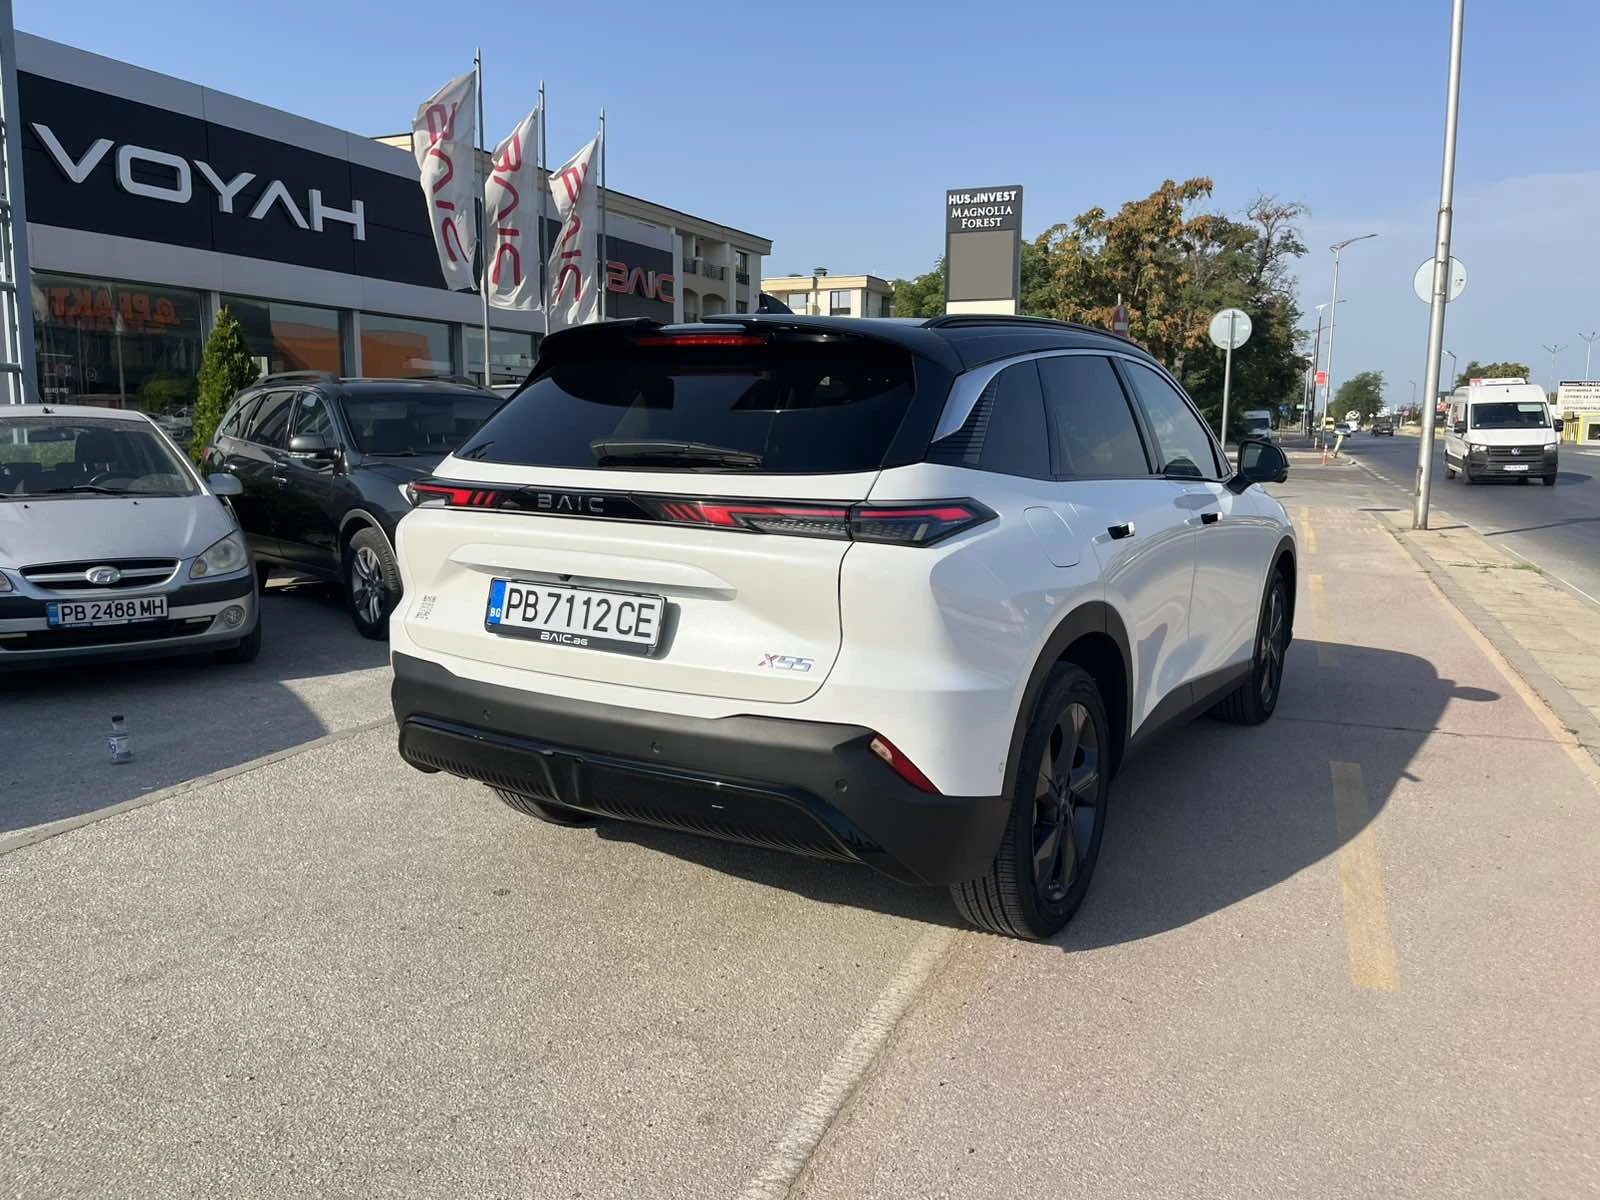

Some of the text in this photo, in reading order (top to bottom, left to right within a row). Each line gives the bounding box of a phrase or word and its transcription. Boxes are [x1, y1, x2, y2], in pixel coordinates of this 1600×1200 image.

[31, 121, 366, 241] VOYAH
[492, 134, 522, 286] BAIC
[951, 205, 1013, 218] MAGNOLIA
[961, 217, 1002, 229] FOREST
[607, 260, 677, 304] BAIC
[537, 493, 604, 513] BAIC
[61, 599, 164, 622] PB 2488 MH
[489, 607, 501, 618] BG
[757, 652, 815, 673] X55
